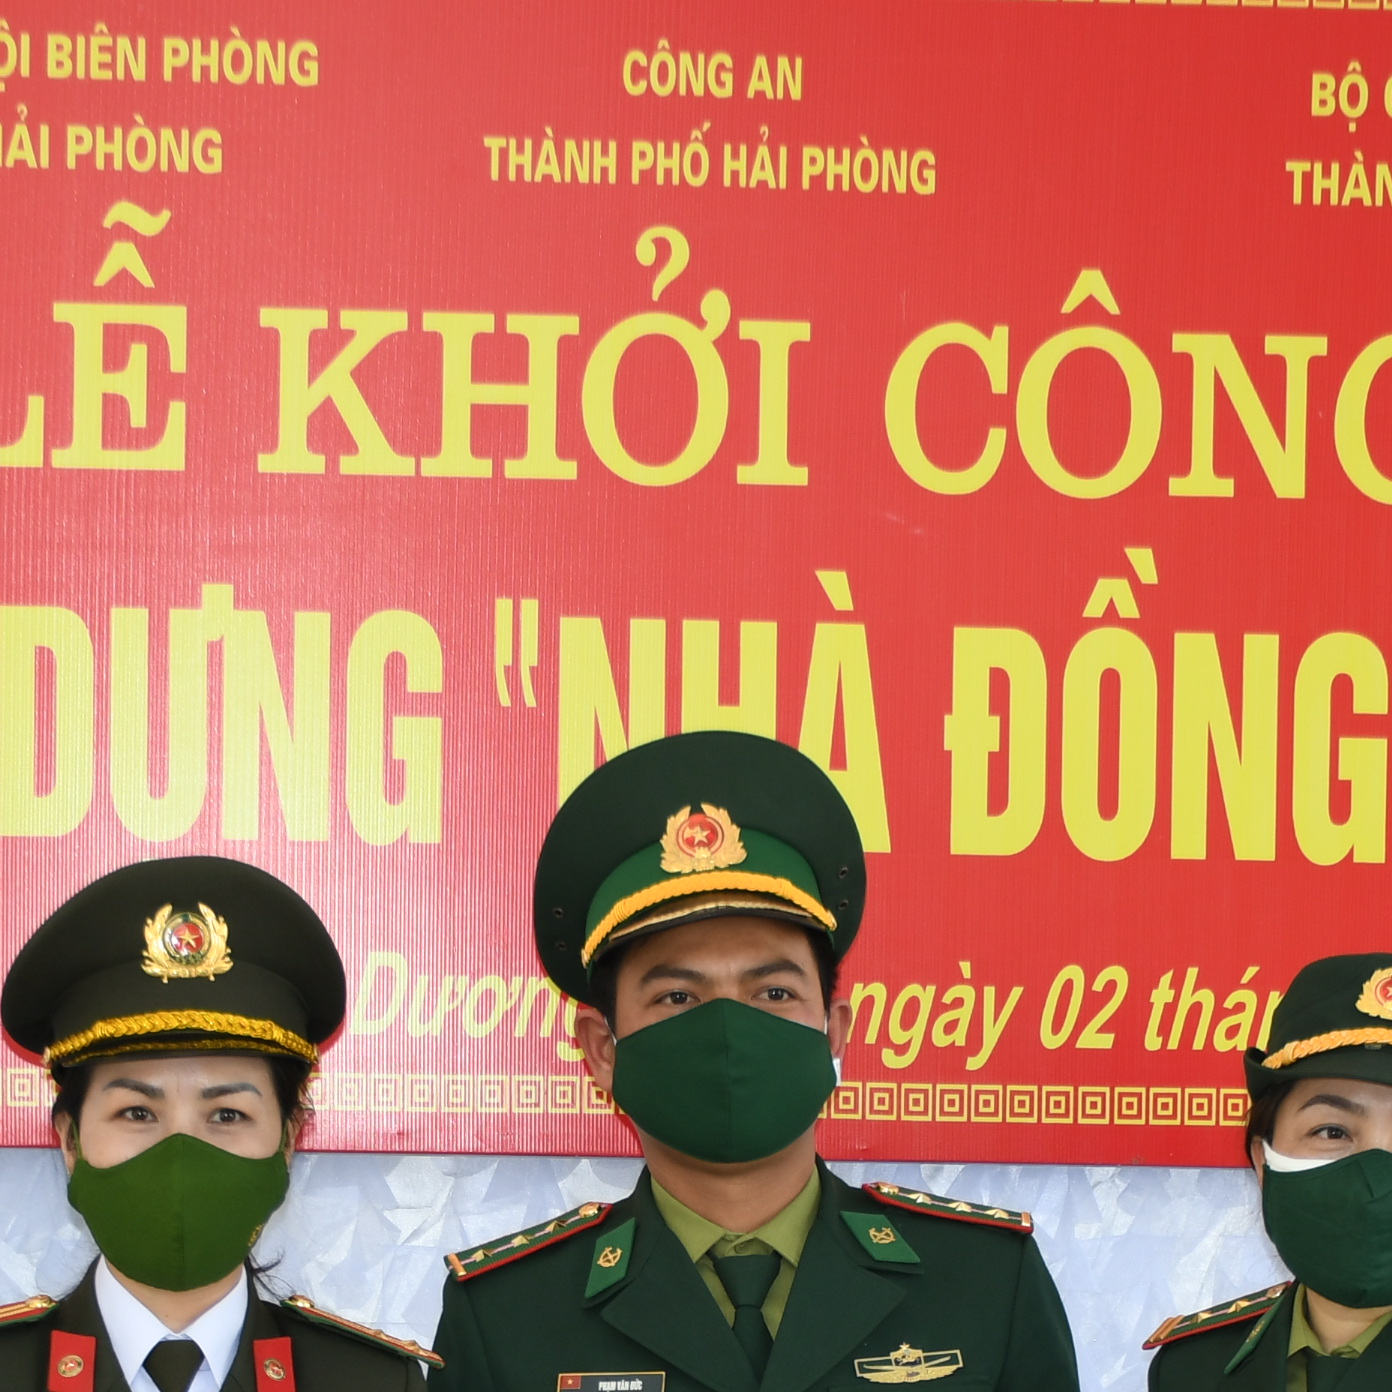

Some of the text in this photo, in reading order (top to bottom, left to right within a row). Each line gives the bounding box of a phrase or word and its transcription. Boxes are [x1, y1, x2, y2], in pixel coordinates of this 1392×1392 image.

[47, 22, 146, 82] BIÊN
[163, 26, 319, 88] PHÒNG
[623, 39, 803, 101] CÔNG AN
[1312, 62, 1368, 132] BỘ
[66, 114, 223, 175] PHÒNG
[484, 122, 936, 195] THÀNH PHỐ HẢI PHÒNG
[257, 225, 811, 488] KHỞI
[944, 547, 1388, 866] ĐỒNG
[846, 961, 1024, 1071] ngày
[1040, 965, 1128, 1050] 02
